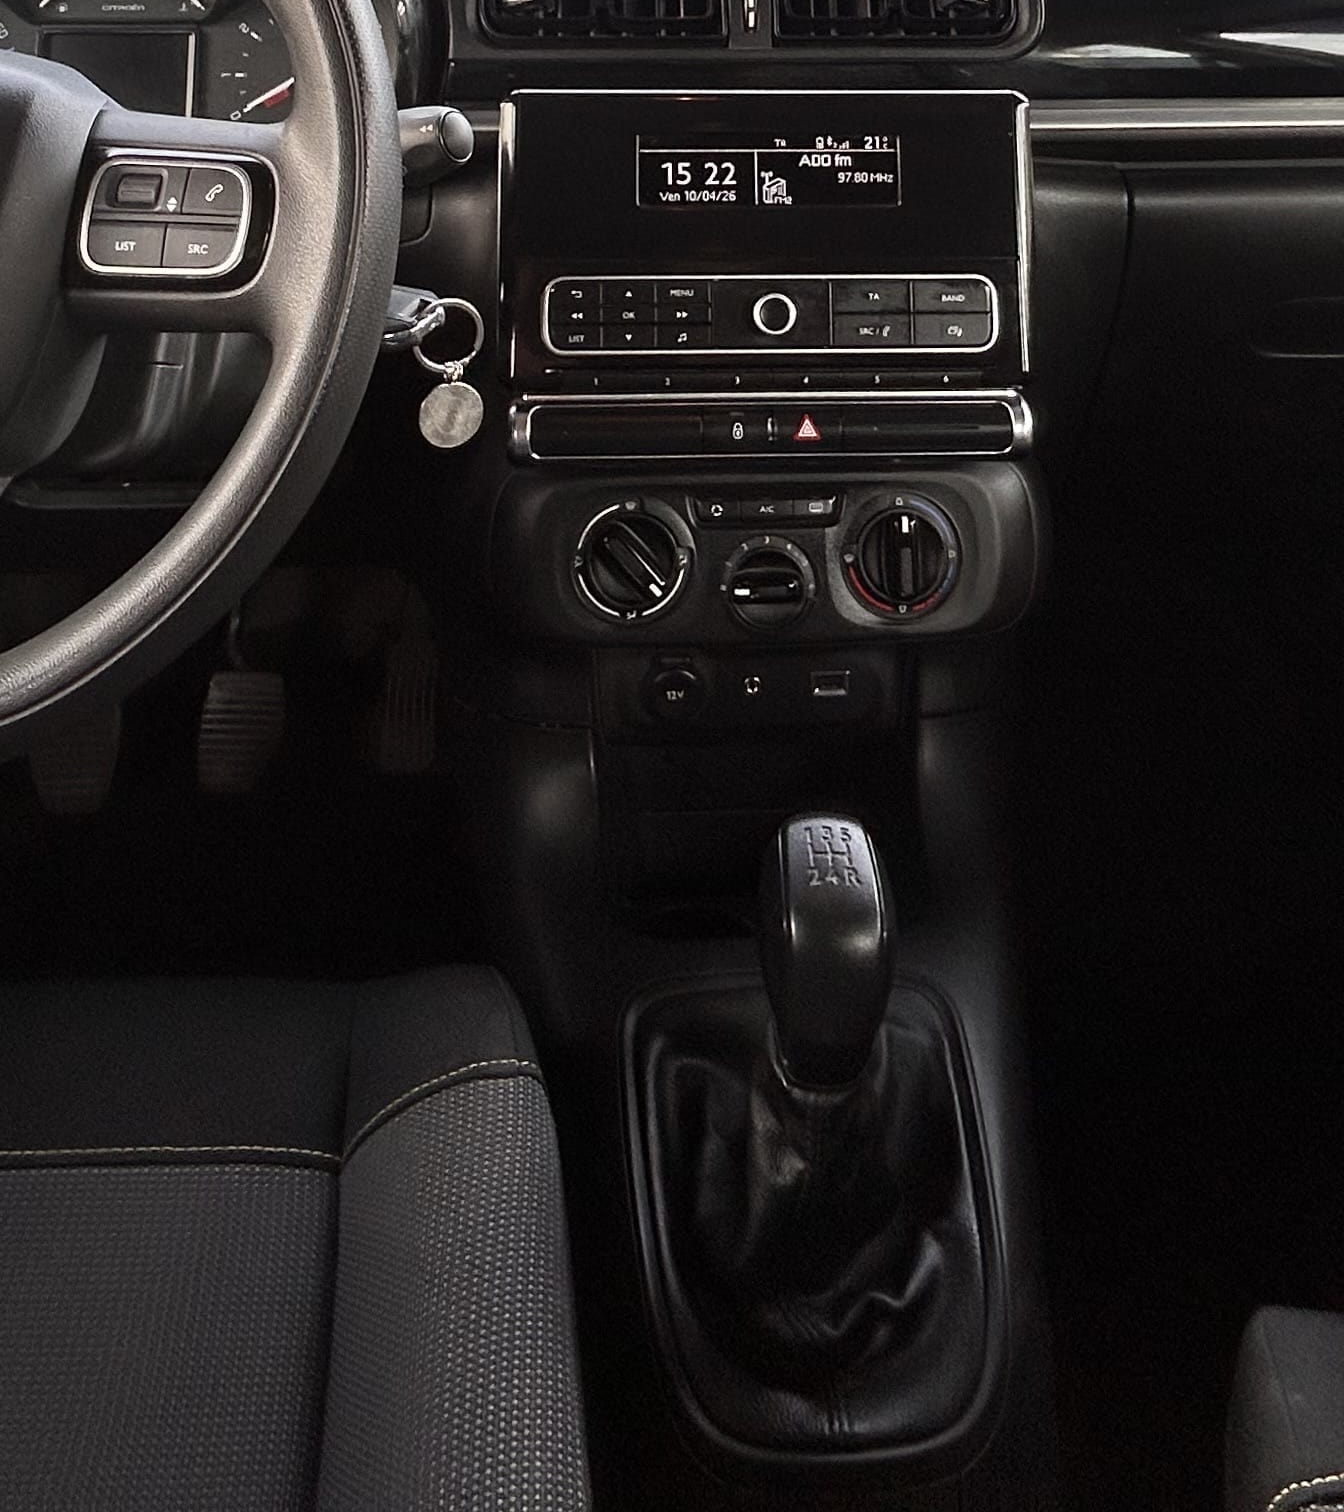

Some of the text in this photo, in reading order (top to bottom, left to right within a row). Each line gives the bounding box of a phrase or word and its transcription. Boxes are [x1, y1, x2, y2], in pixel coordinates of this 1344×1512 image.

[238, 22, 250, 34] 2
[661, 162, 738, 186] 15 22
[837, 172, 895, 184] 97.80 MHz
[659, 190, 737, 202] Ven 10/04/26
[115, 240, 137, 252] LIST
[187, 243, 209, 255] SRC
[669, 288, 694, 297] MENU
[868, 292, 880, 301] TA
[941, 294, 966, 303] BAND
[622, 310, 636, 320] OK
[568, 334, 585, 344] LIST
[666, 688, 684, 701] 12V
[807, 868, 821, 886] 2
[843, 867, 862, 887] R
